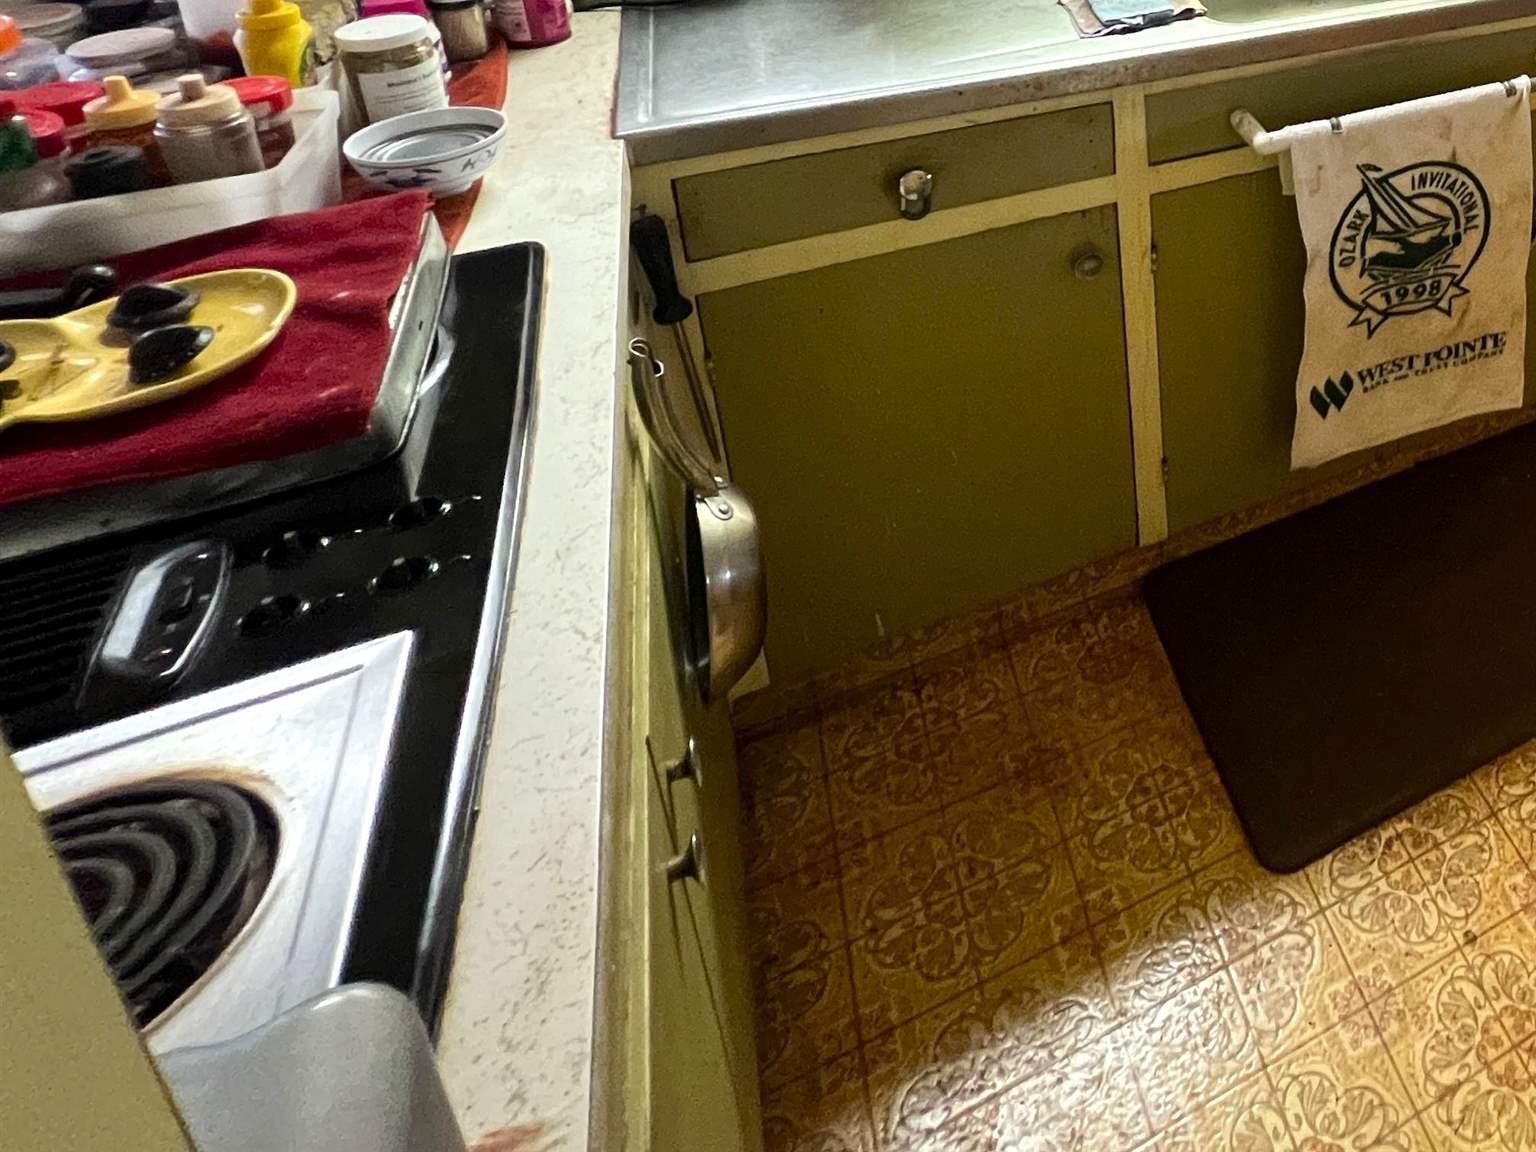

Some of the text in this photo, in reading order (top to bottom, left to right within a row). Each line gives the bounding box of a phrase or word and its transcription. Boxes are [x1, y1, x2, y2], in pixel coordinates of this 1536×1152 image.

[1339, 171, 1479, 268] OZARK INVITATIONAL
[1381, 279, 1442, 305] 1998
[1357, 331, 1507, 385] WEST POINTE
